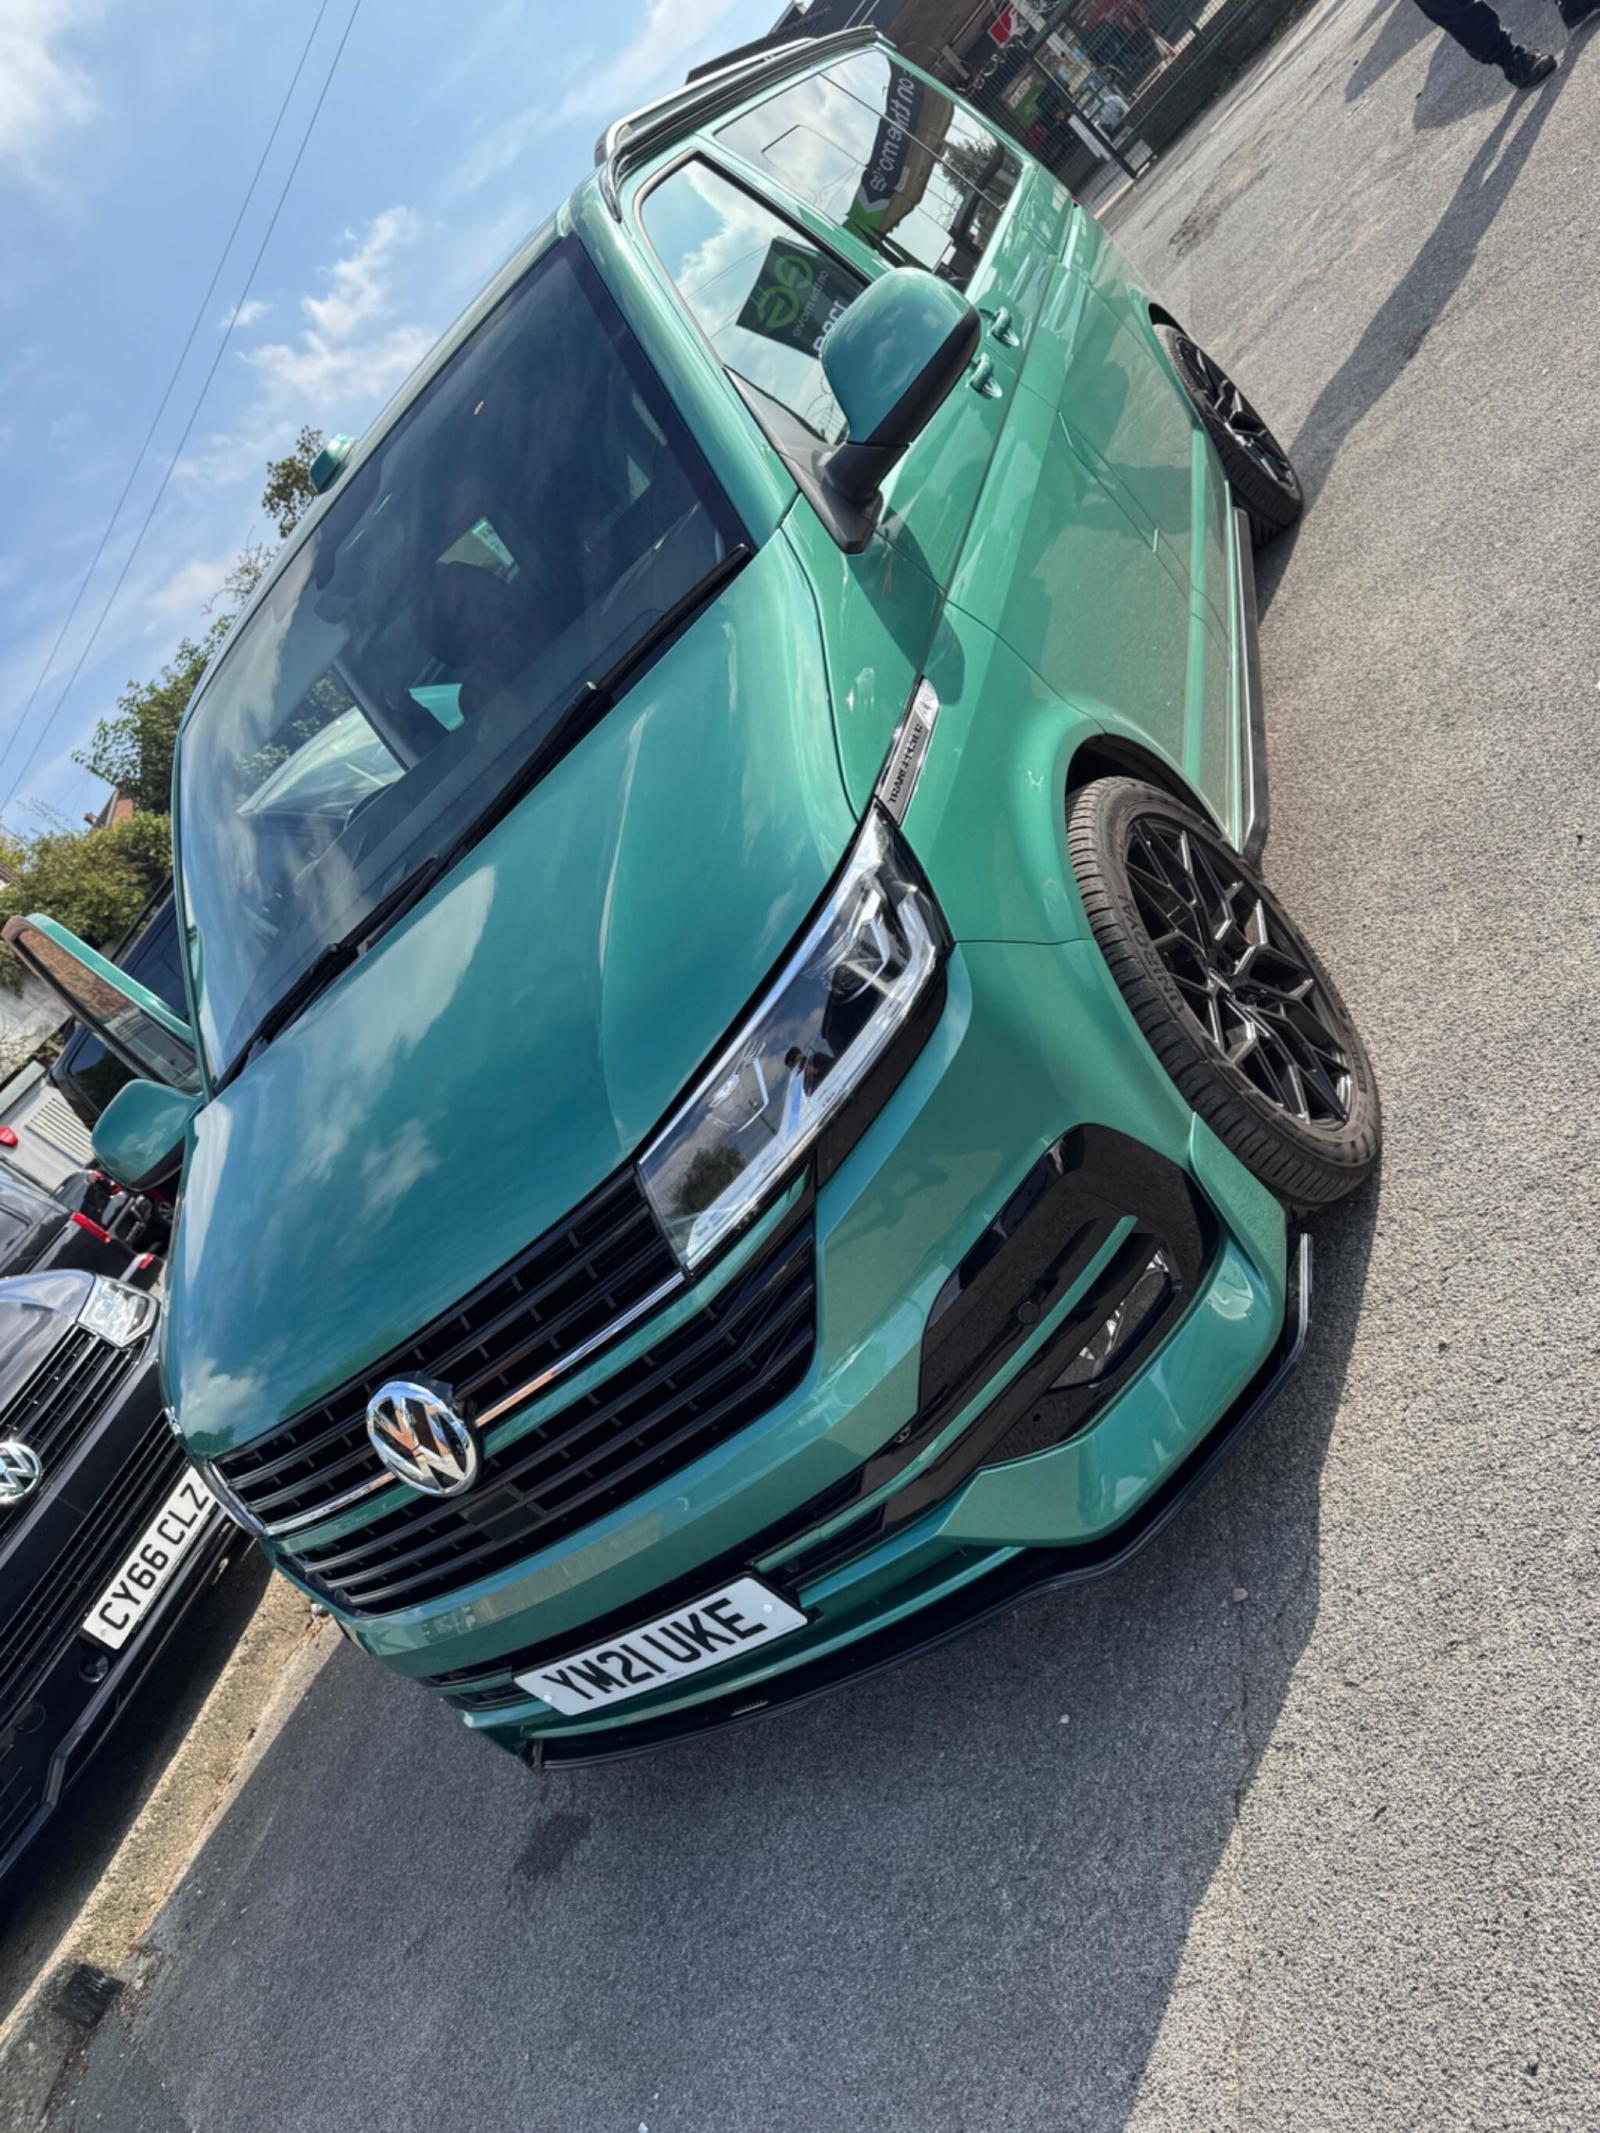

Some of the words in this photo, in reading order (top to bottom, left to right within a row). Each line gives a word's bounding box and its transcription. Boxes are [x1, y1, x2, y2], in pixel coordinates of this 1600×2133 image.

[99, 1543, 169, 1631] CY66
[157, 1483, 210, 1546] CLZ
[541, 1643, 666, 1701] YM21
[641, 1597, 767, 1664] UKE
